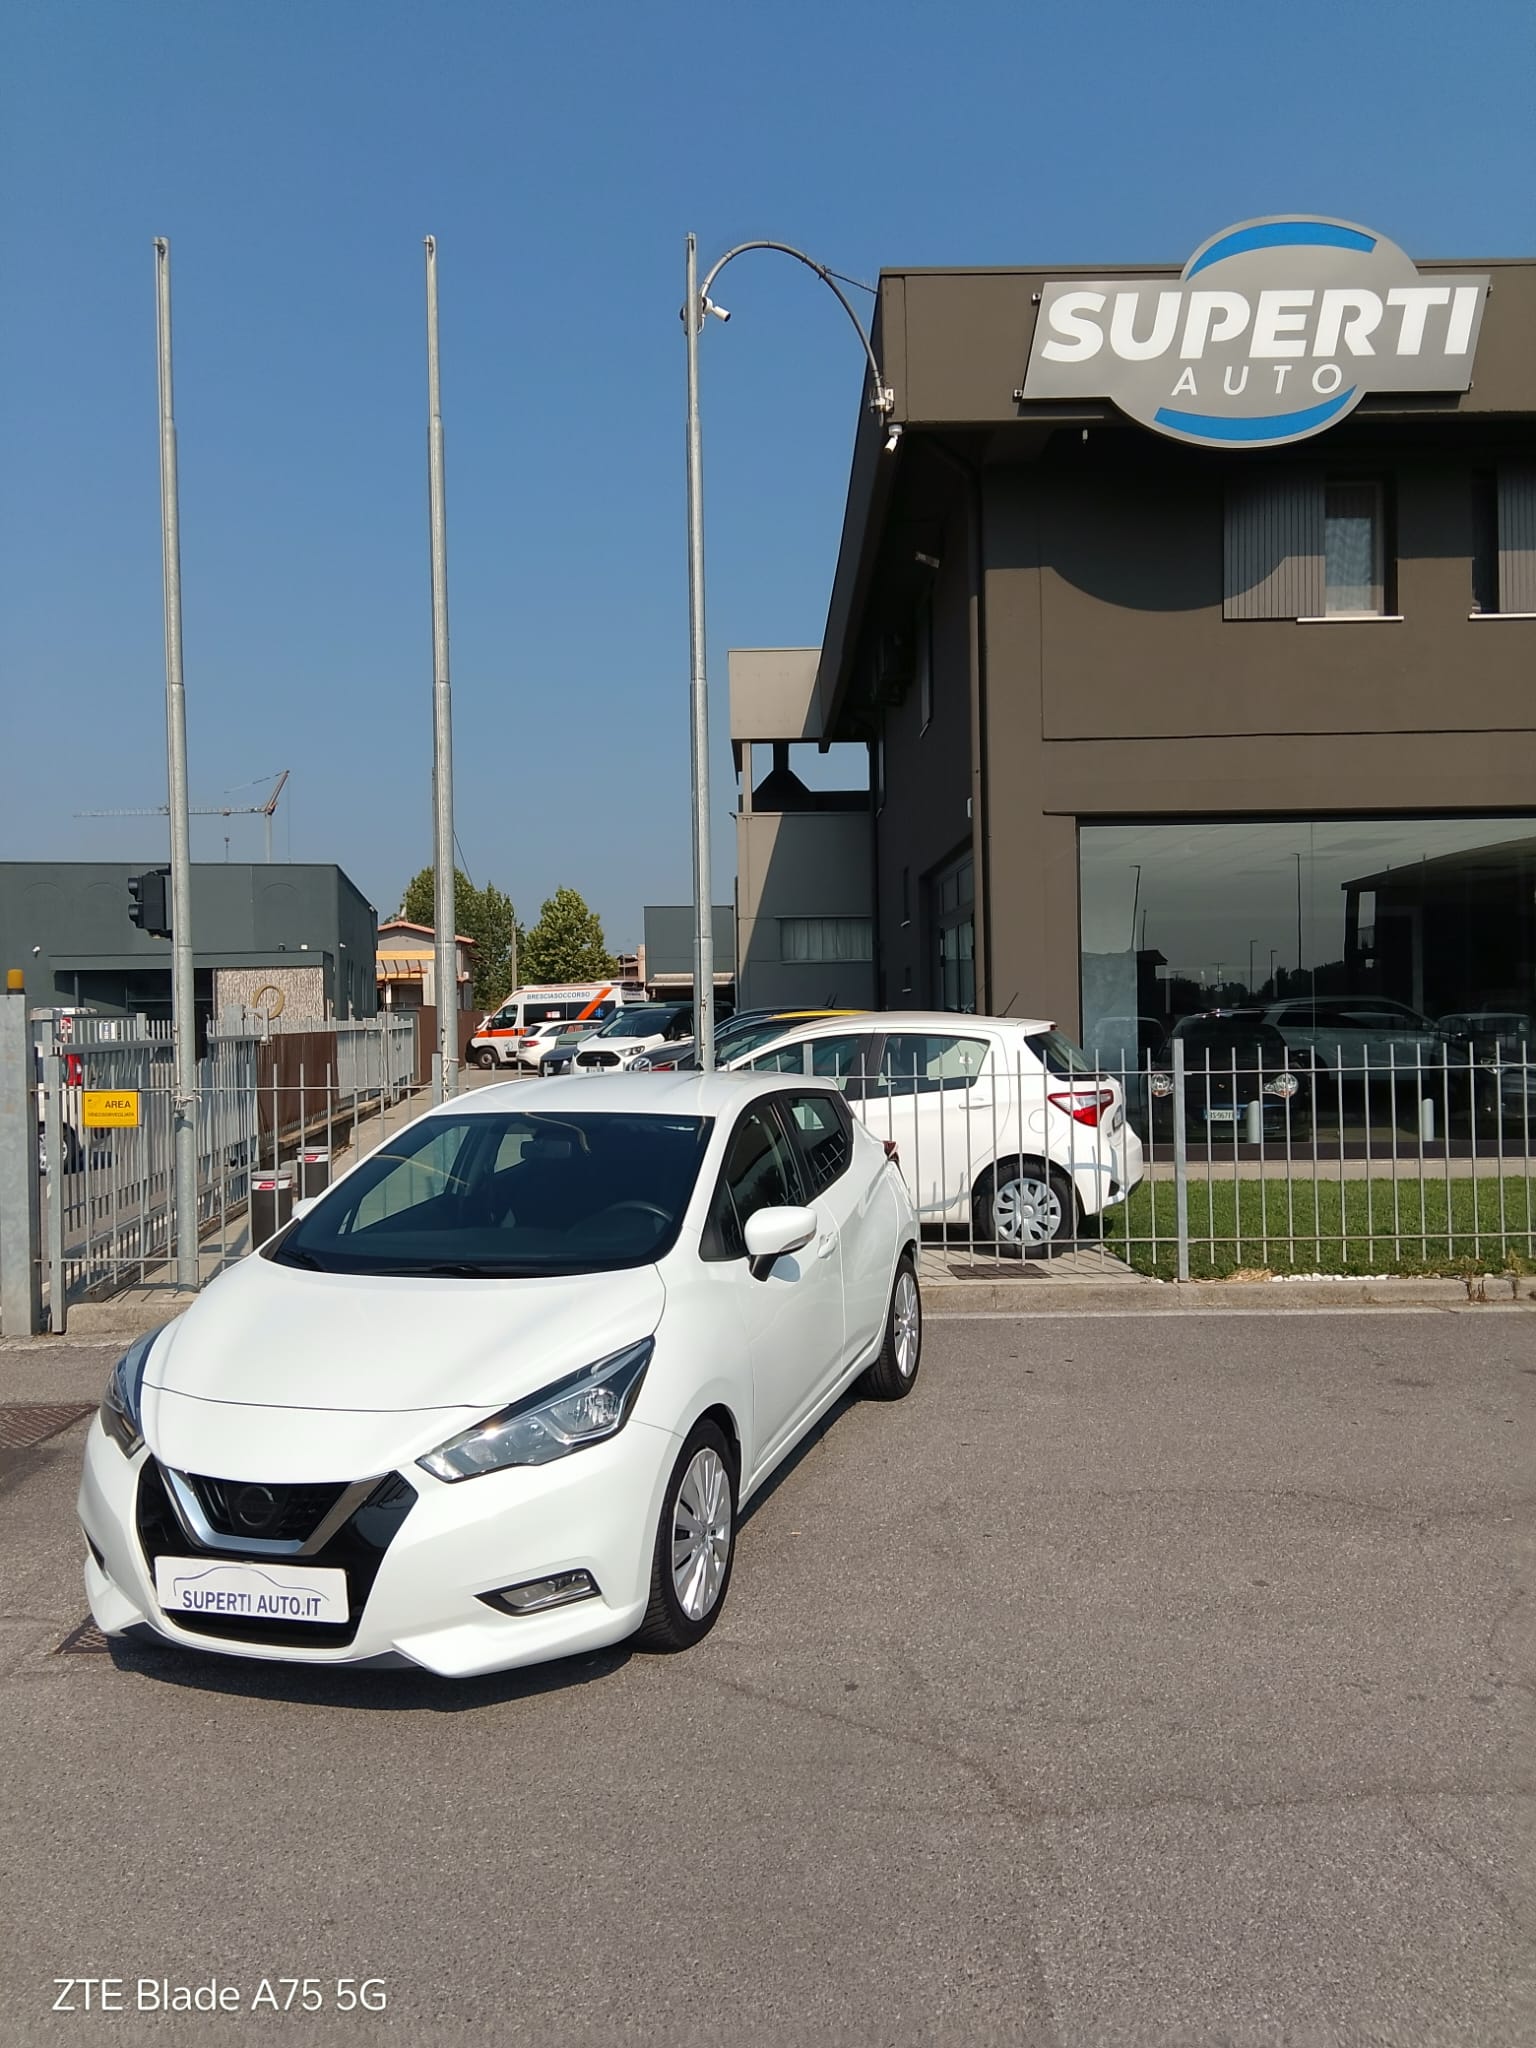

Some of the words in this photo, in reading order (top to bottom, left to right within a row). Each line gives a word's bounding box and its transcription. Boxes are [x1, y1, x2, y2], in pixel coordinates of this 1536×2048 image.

[1041, 286, 1479, 362] SUPERTI
[1171, 363, 1343, 396] AUTO
[526, 991, 591, 1000] BRESCIASOCCORSO
[105, 1100, 131, 1109] AREA
[182, 1590, 252, 1613] SUPERTI
[256, 1594, 322, 1617] AUTO.IT
